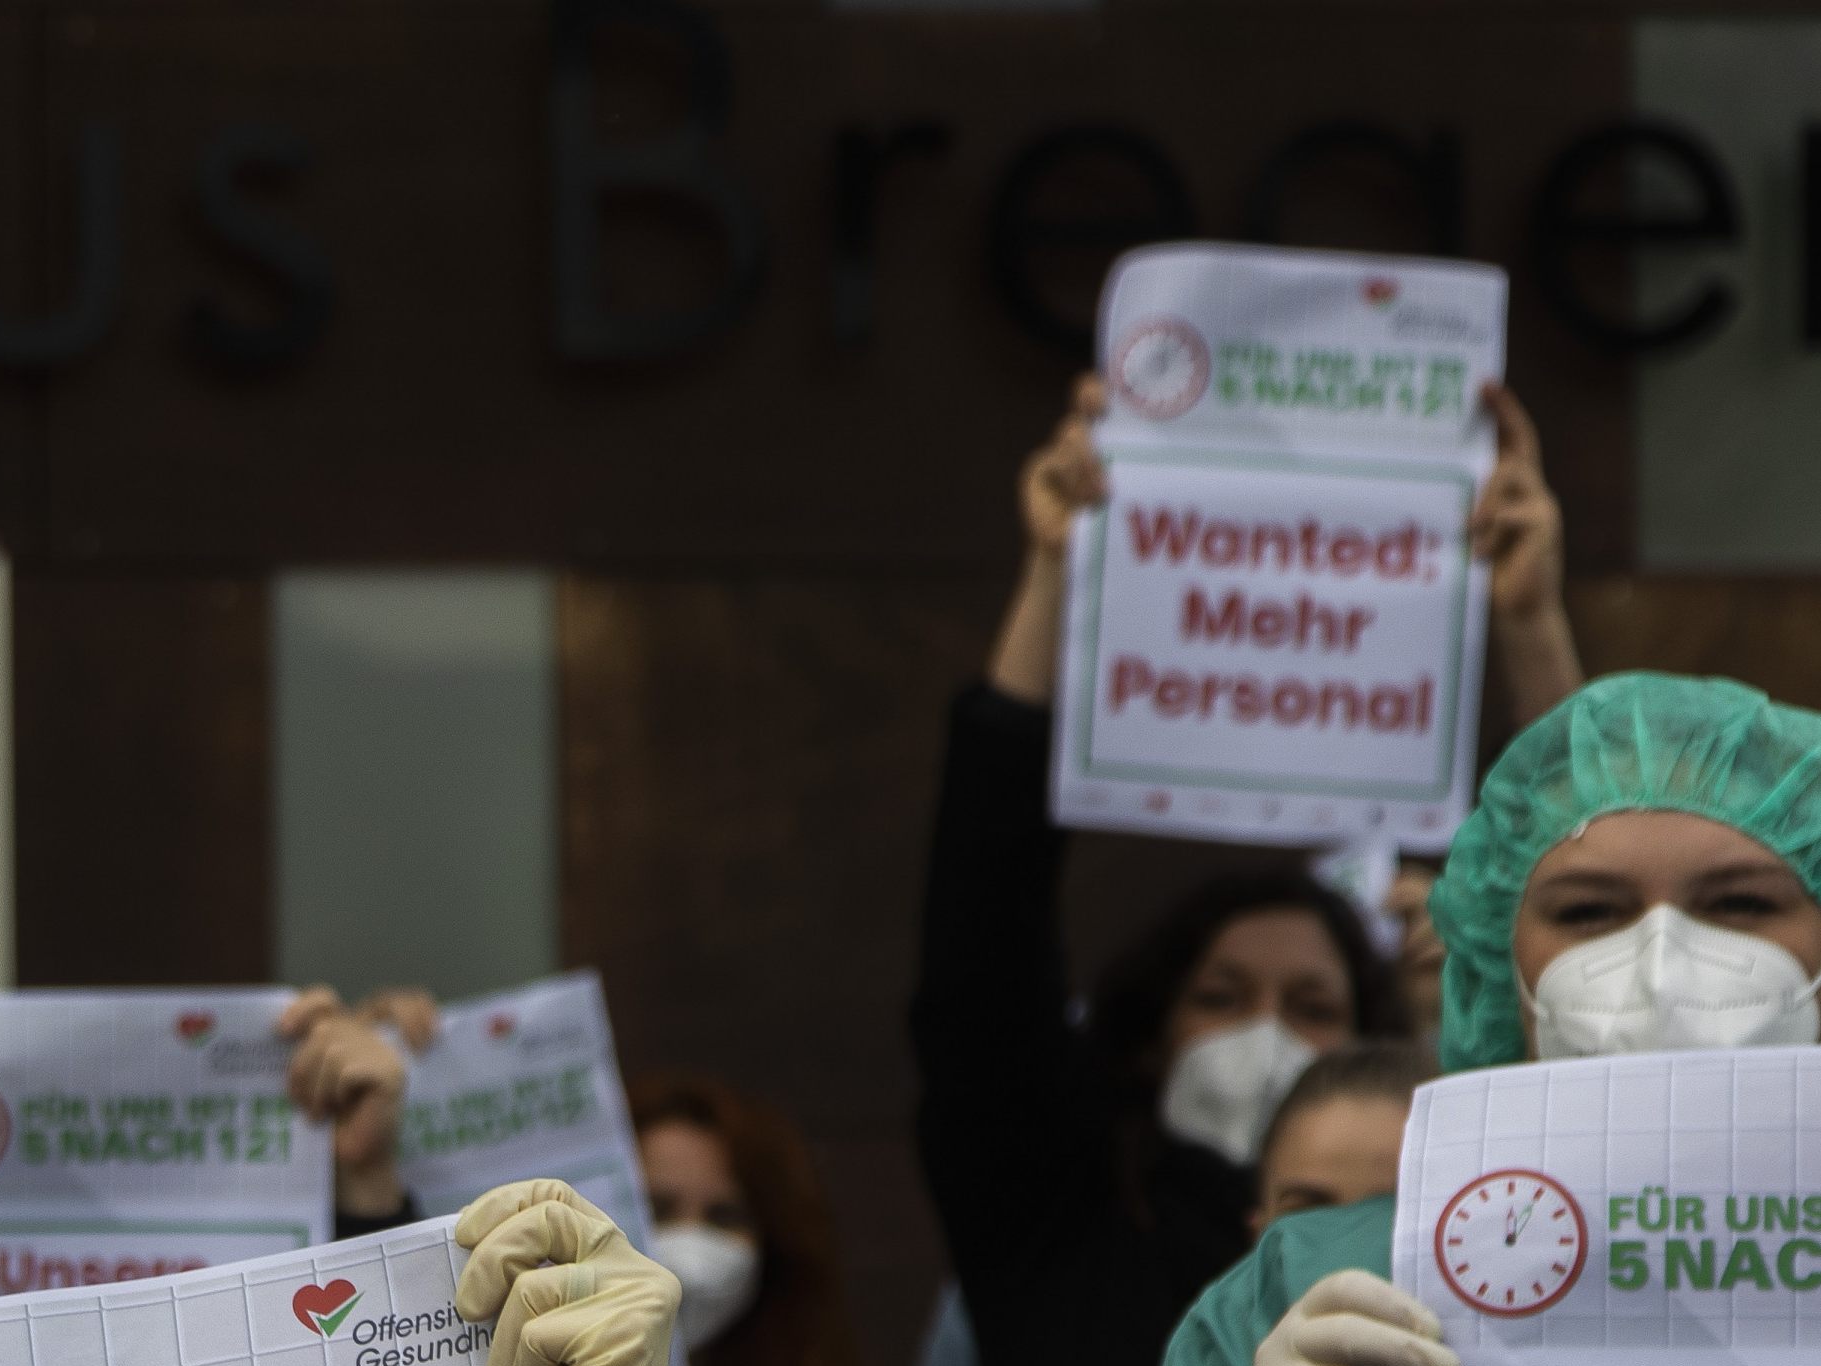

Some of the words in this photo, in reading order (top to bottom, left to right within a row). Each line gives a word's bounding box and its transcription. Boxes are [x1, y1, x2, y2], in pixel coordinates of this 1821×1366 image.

[1128, 504, 1440, 583] Wanted:
[1181, 586, 1377, 654] Mehr
[1108, 654, 1434, 736] Personal
[60, 1127, 205, 1164] NACH
[1608, 1185, 1706, 1233] FÜR
[1608, 1239, 1650, 1291] 5
[1665, 1238, 1821, 1291] NAC
